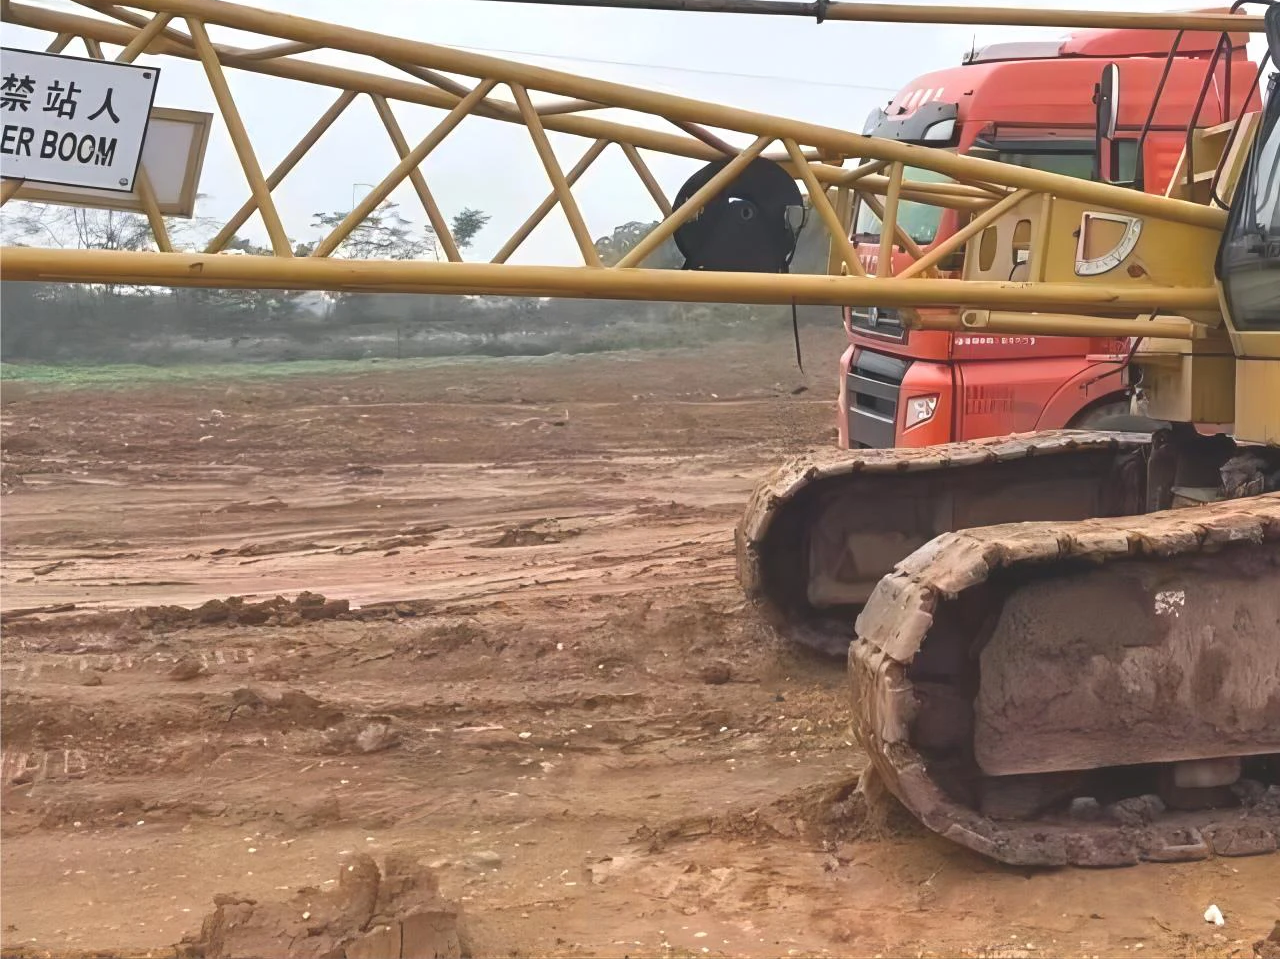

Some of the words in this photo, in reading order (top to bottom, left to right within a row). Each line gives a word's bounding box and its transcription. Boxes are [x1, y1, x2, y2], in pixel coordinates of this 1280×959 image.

[0, 72, 121, 124] 禁站人
[0, 124, 35, 157] ER
[39, 129, 118, 167] BOOM
